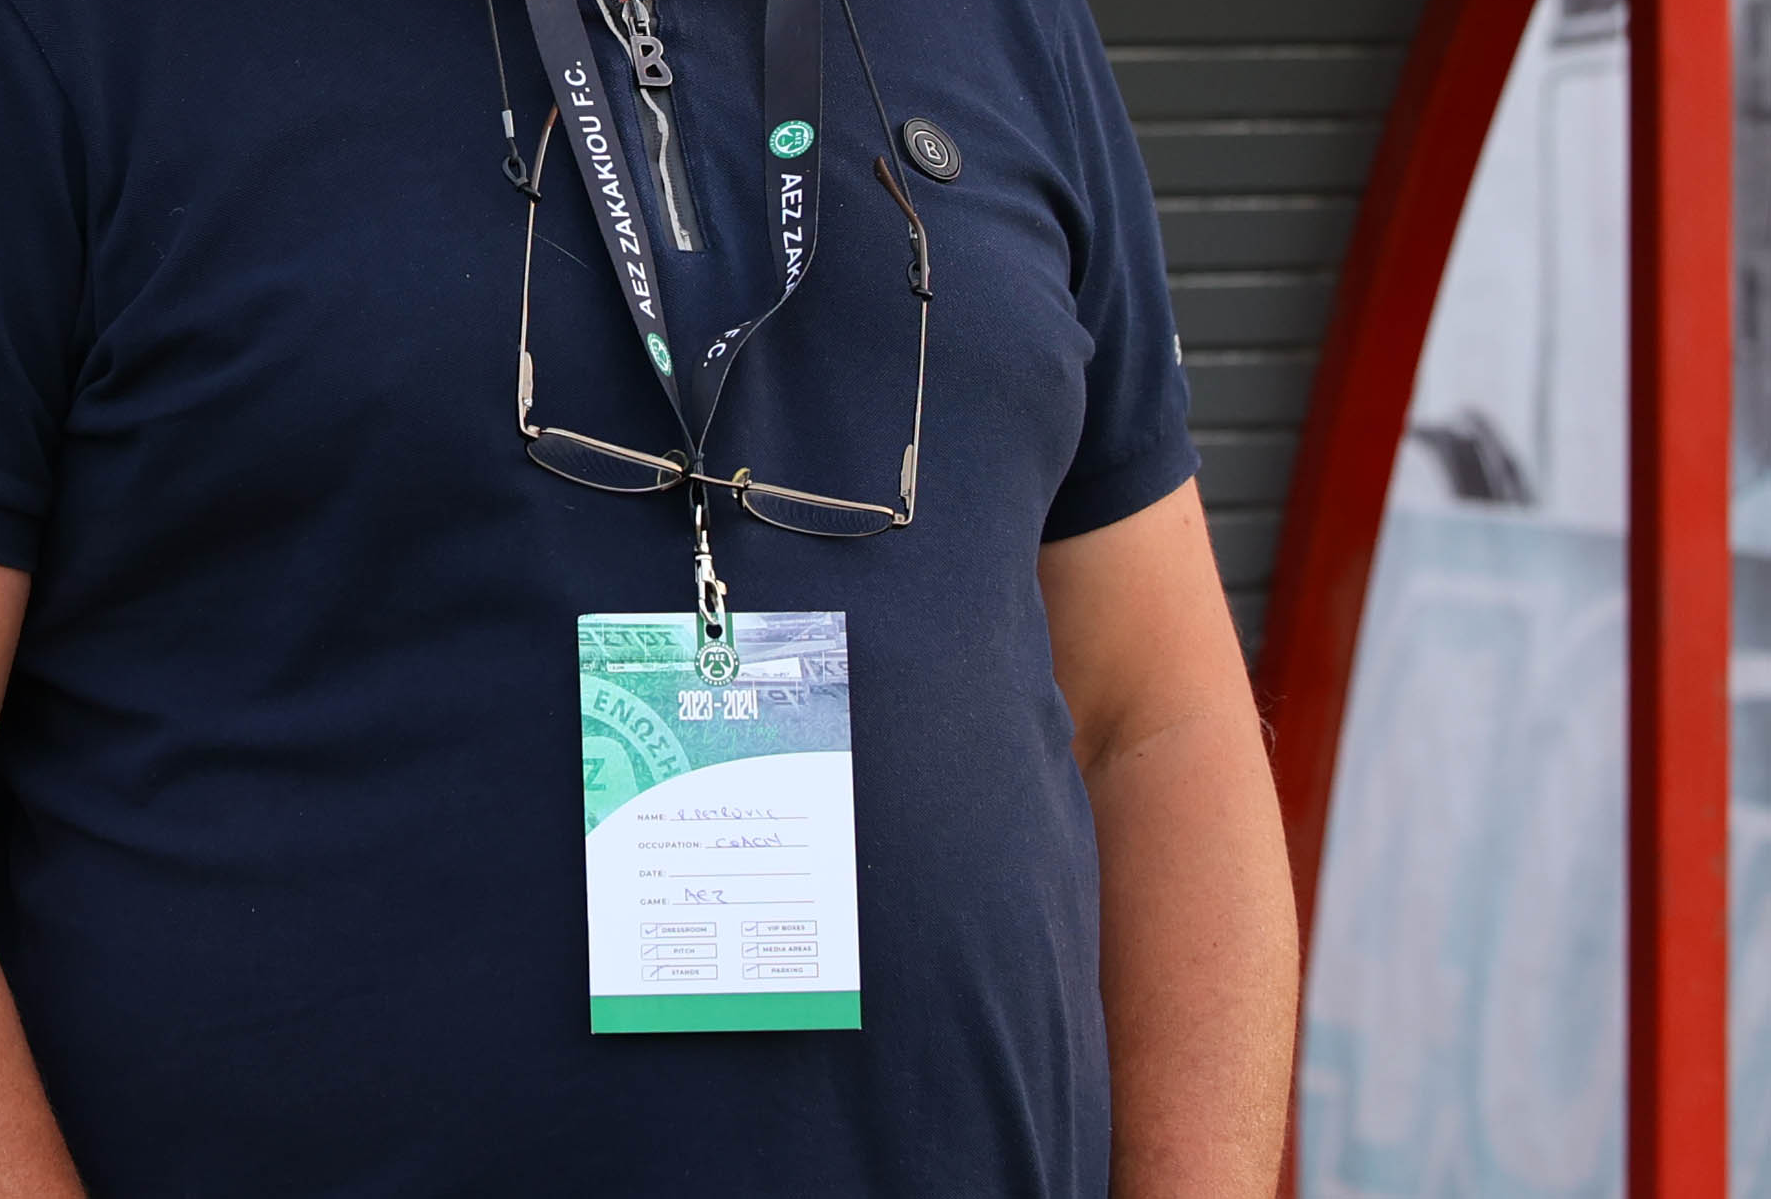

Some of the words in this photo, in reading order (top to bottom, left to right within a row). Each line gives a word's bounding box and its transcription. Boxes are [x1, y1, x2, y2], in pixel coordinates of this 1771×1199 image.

[564, 60, 595, 107] F.C.
[578, 116, 640, 254] ZAKAKIOU
[780, 173, 803, 225] AEZ
[782, 226, 804, 296] ZAK
[628, 262, 656, 320] AEZ
[708, 653, 726, 662] AEZ
[637, 813, 666, 821] NAME:
[638, 841, 702, 849] OCCUPATION:
[639, 870, 666, 878] DATE:
[640, 898, 669, 906] GAME:
[673, 947, 696, 955] PITCH
[771, 966, 804, 974] PARKING
